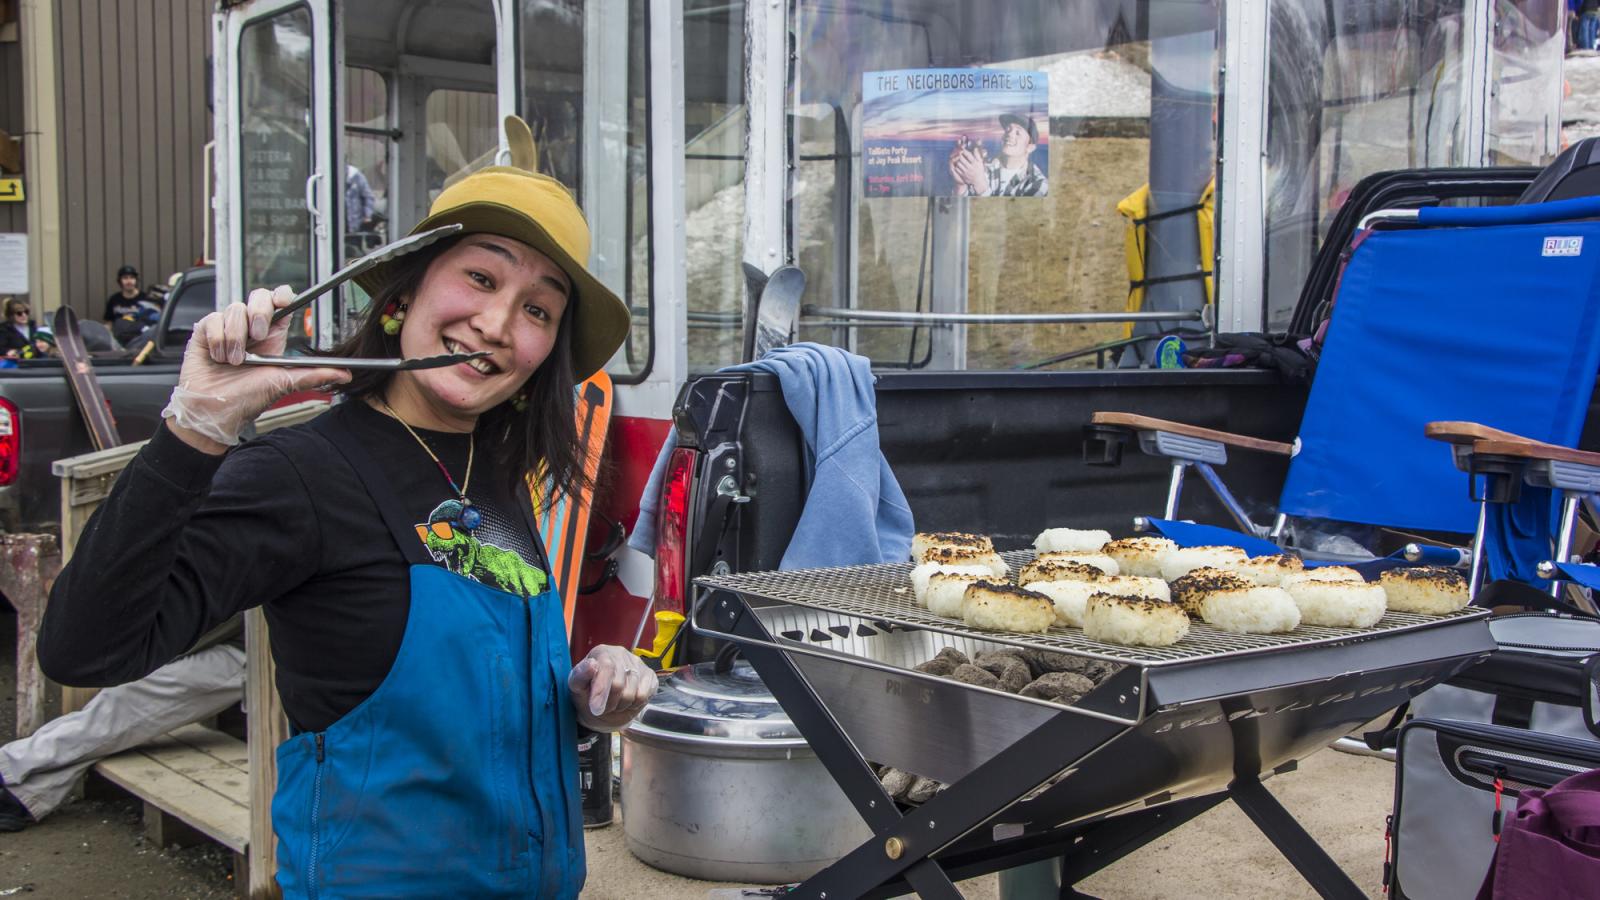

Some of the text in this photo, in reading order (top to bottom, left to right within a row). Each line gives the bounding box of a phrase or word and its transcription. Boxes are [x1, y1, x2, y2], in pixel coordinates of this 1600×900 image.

[877, 75, 898, 91] THE
[906, 73, 975, 90] NEIGHBORS
[982, 74, 1012, 89] HATE
[891, 146, 908, 156] Party
[868, 157, 874, 165] at
[876, 157, 886, 166] Jay
[887, 156, 901, 164] Peak
[1547, 240, 1579, 249] RIO
[886, 679, 931, 704] PRIUS
